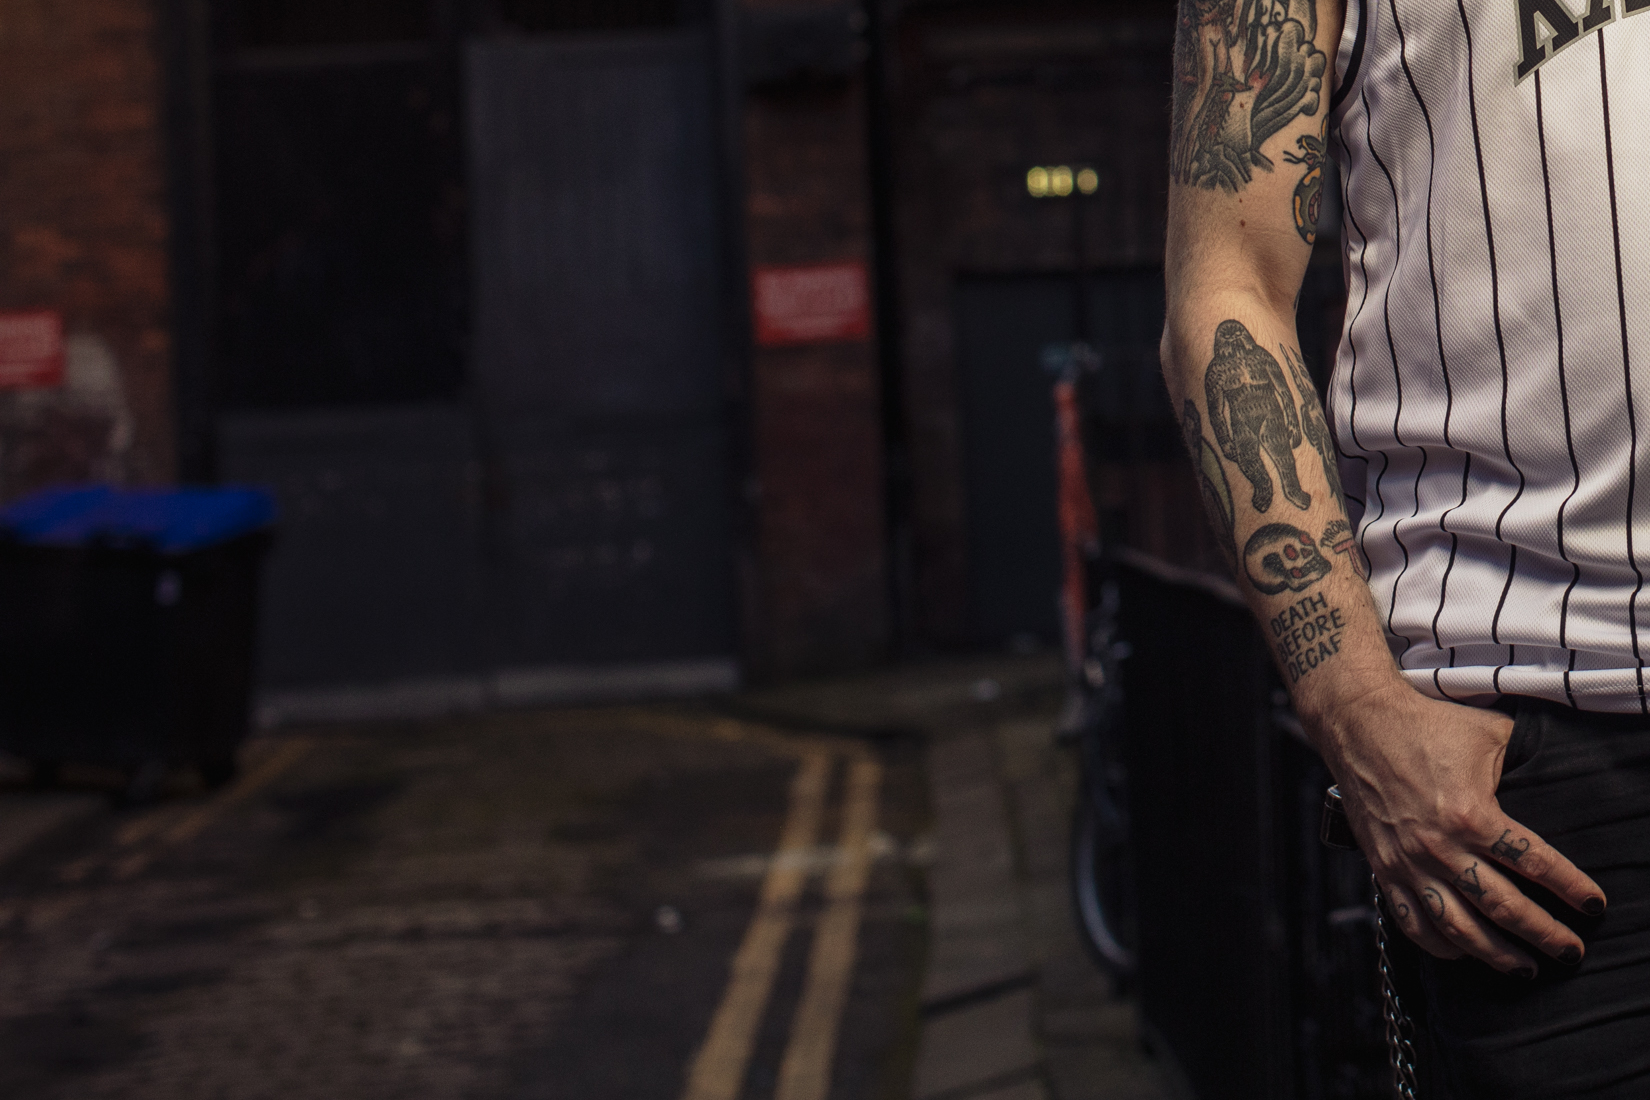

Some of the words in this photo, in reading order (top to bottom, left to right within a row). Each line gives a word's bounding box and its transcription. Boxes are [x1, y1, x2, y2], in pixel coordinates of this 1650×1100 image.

[1271, 591, 1328, 638] DEATH
[1277, 607, 1347, 664] BEFORE
[1288, 631, 1342, 683] DECAF
